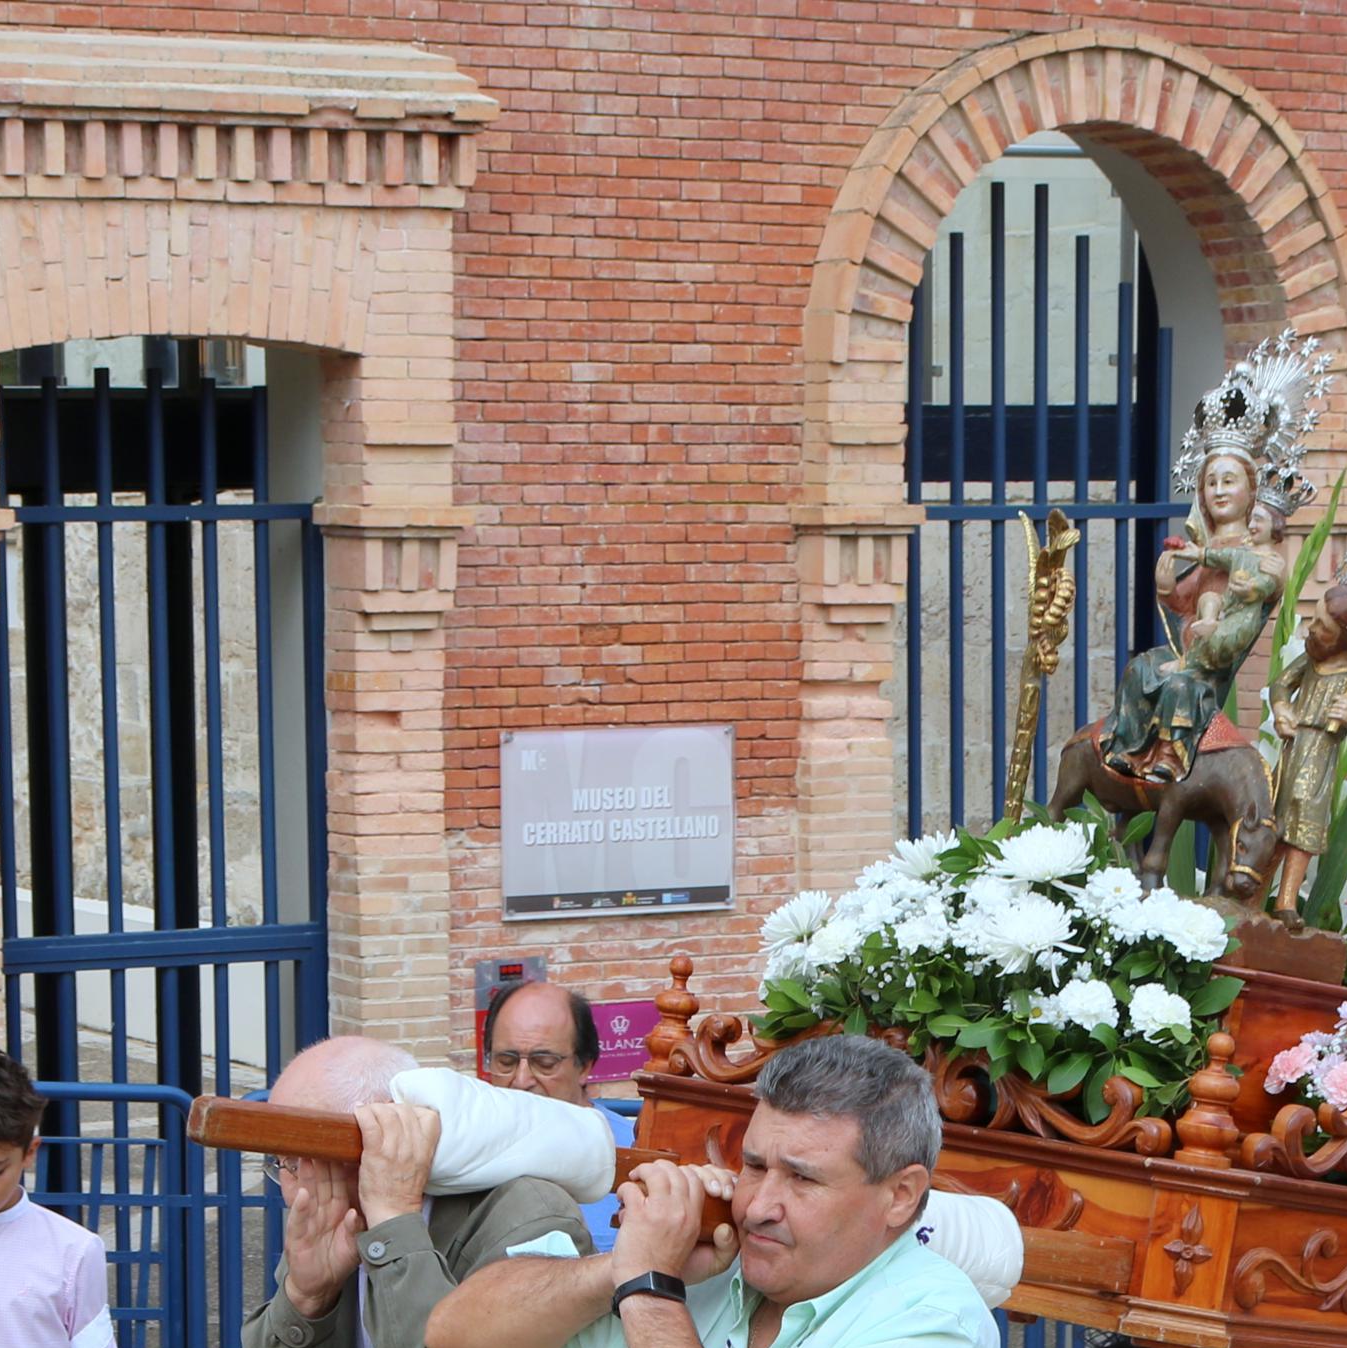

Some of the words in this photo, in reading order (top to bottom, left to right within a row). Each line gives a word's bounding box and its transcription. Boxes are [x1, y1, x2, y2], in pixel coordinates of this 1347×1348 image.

[572, 787, 637, 813] MUSEO
[640, 785, 672, 810] DEL
[523, 820, 605, 847] CERRATO
[608, 815, 720, 842] CASTELLANO
